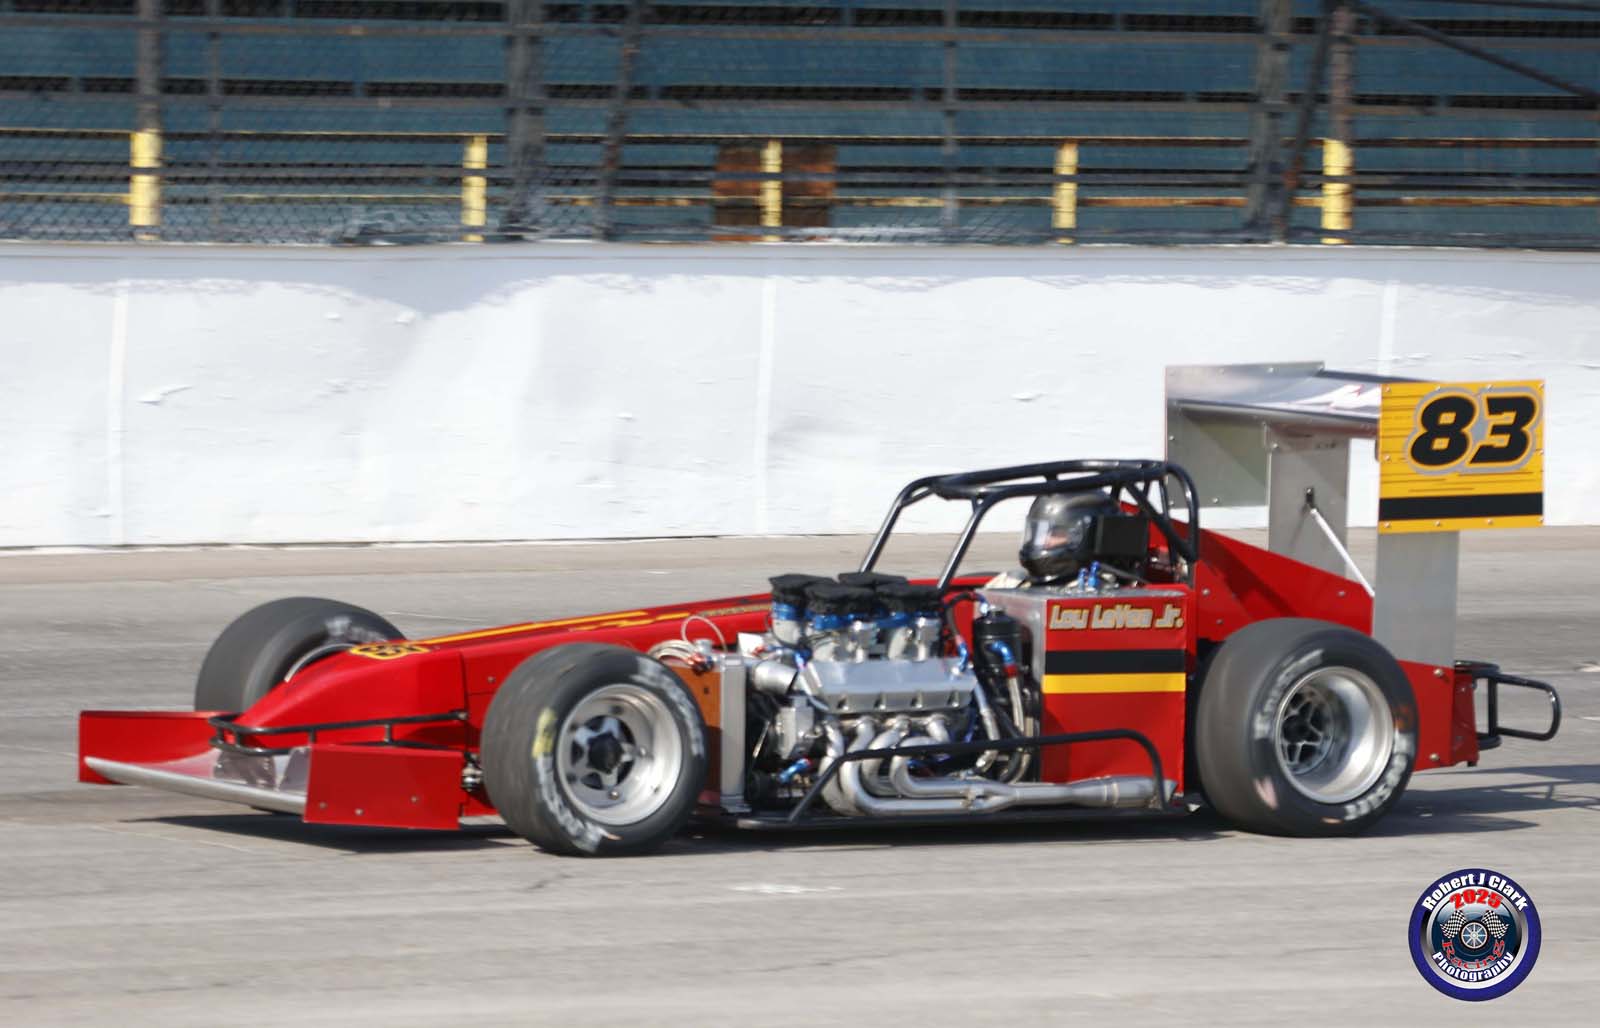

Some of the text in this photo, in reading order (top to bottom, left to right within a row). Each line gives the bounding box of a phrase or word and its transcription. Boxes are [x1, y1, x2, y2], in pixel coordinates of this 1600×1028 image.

[1409, 393, 1538, 468] 83
[1050, 605, 1089, 630] Lou
[1155, 604, 1184, 628] Jr.
